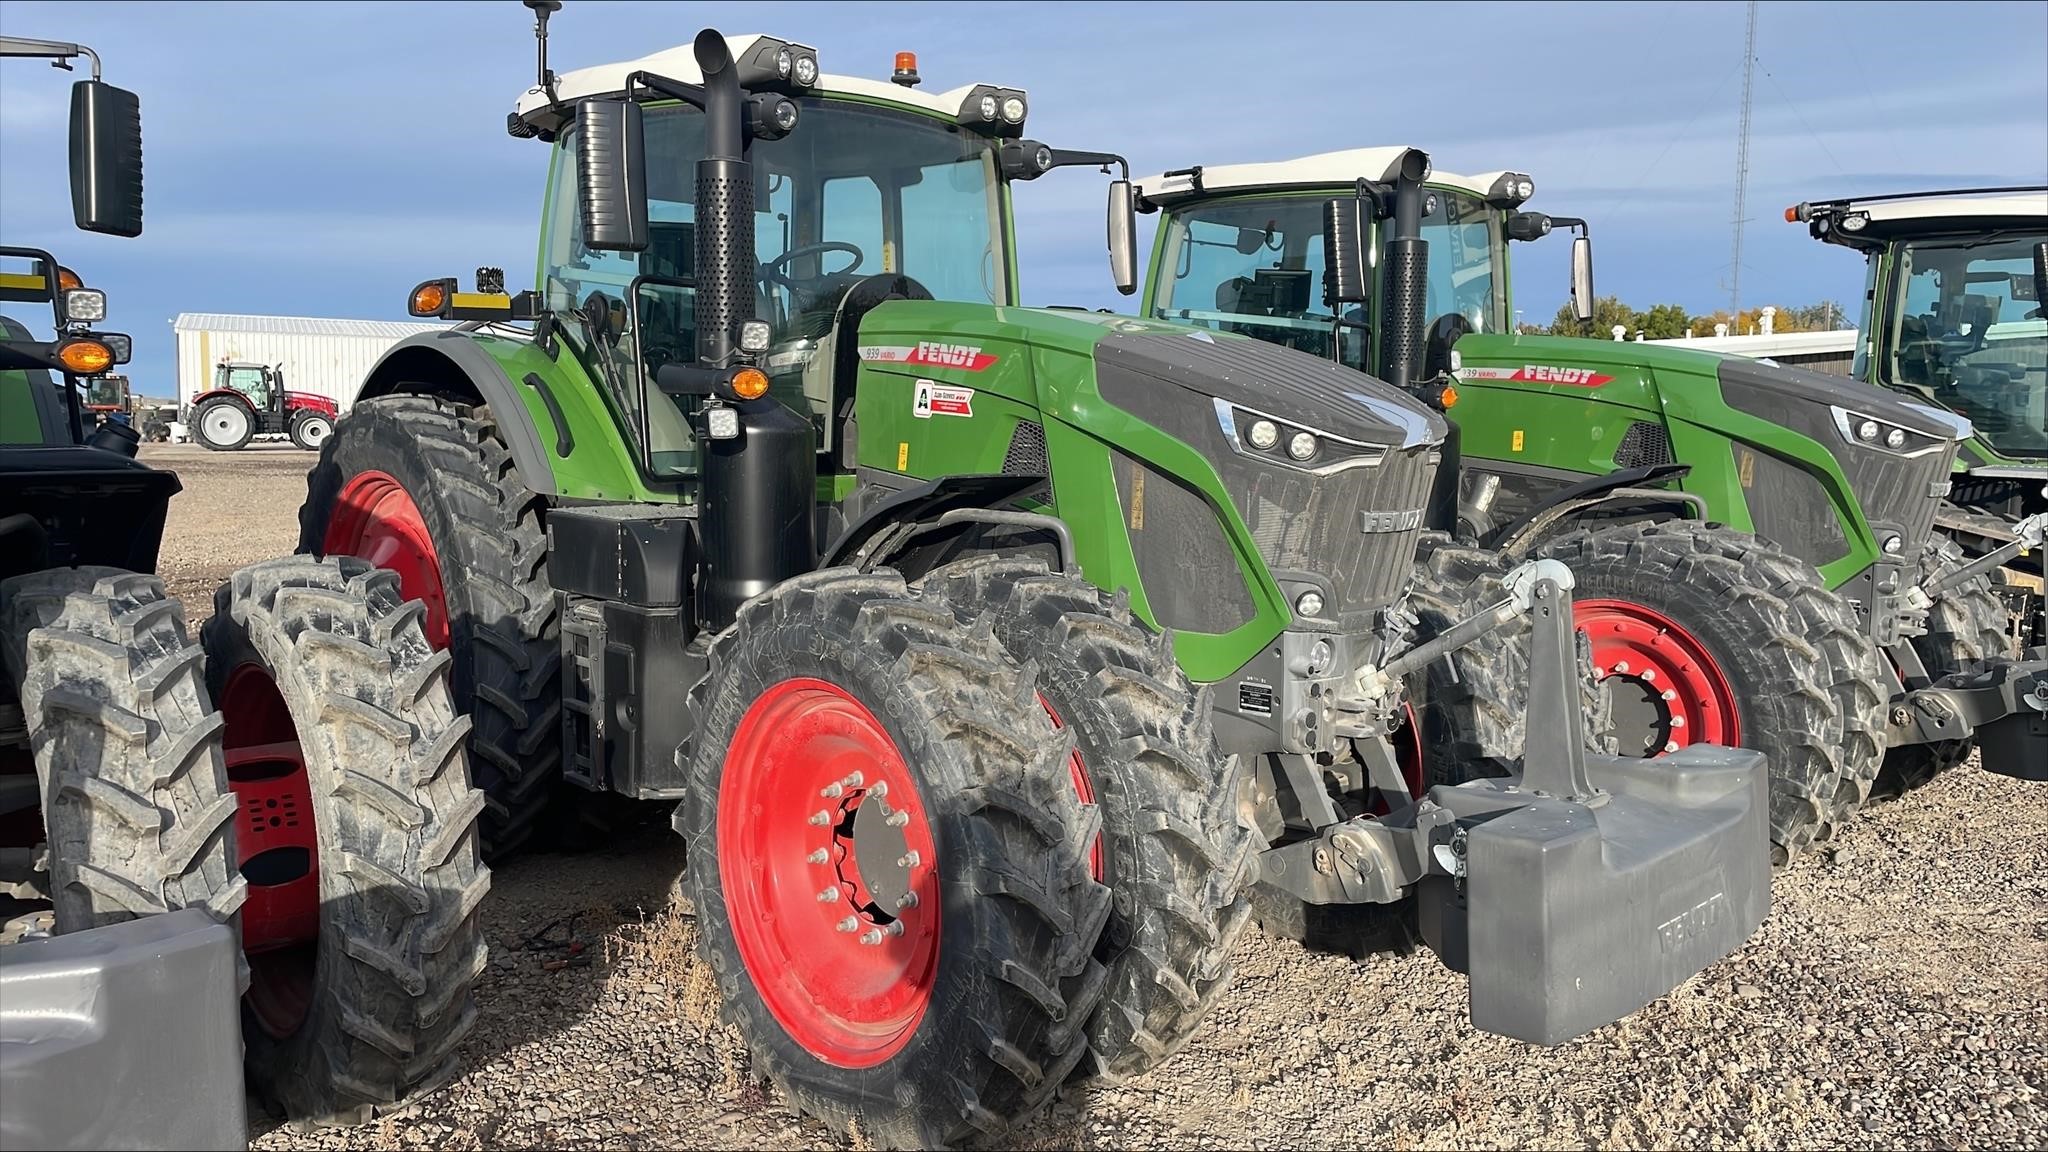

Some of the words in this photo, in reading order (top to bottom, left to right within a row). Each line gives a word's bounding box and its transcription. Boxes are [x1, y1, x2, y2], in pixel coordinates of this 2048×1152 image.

[866, 348, 880, 359] 939
[880, 351, 896, 360] VARIO
[917, 341, 982, 367] FENDT
[1524, 364, 1597, 384] FENDT
